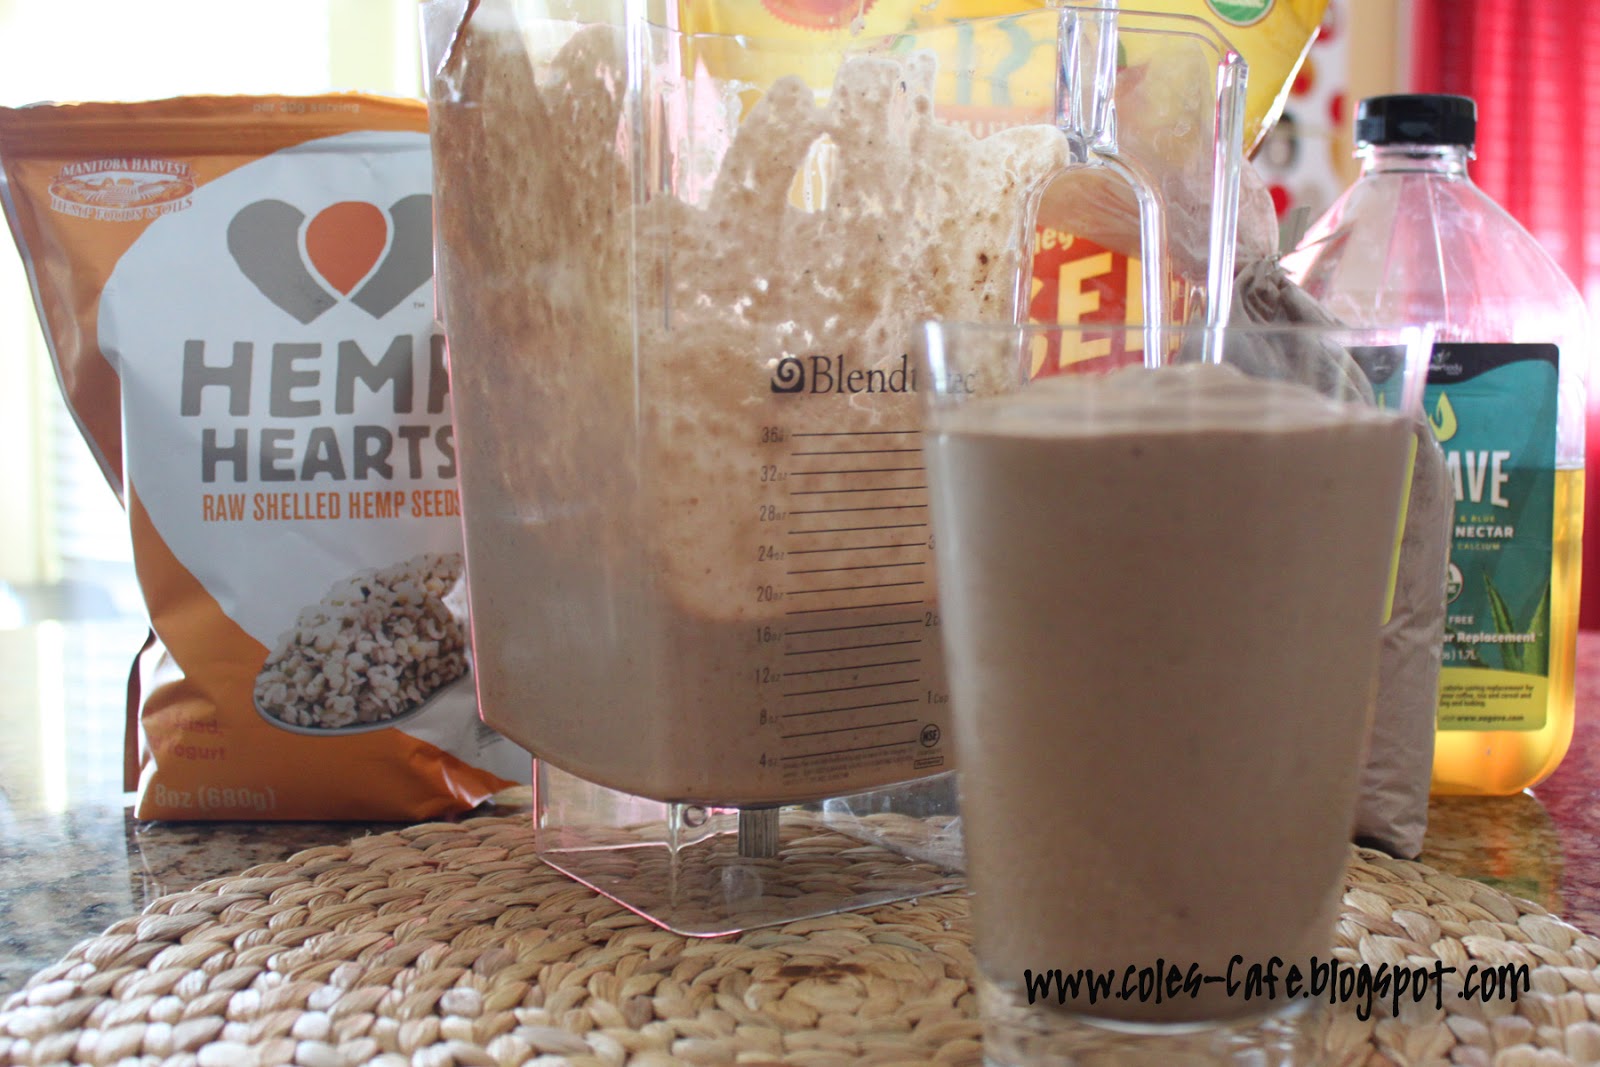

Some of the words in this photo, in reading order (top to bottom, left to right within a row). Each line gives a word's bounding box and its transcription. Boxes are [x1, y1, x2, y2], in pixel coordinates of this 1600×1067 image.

[62, 158, 129, 176] MANITOBA
[131, 158, 190, 175] HARVEST
[201, 425, 458, 483] HEARTS
[203, 494, 246, 522] RAW
[253, 492, 341, 520] SHELLED
[349, 491, 405, 519] HEMP
[411, 489, 463, 518] SEEDS
[1471, 515, 1496, 523] BLUE
[1455, 526, 1514, 538] NECTAR
[1457, 543, 1500, 551] CALCIUM
[1449, 616, 1474, 625] FREE
[1457, 631, 1536, 645] Replacement
